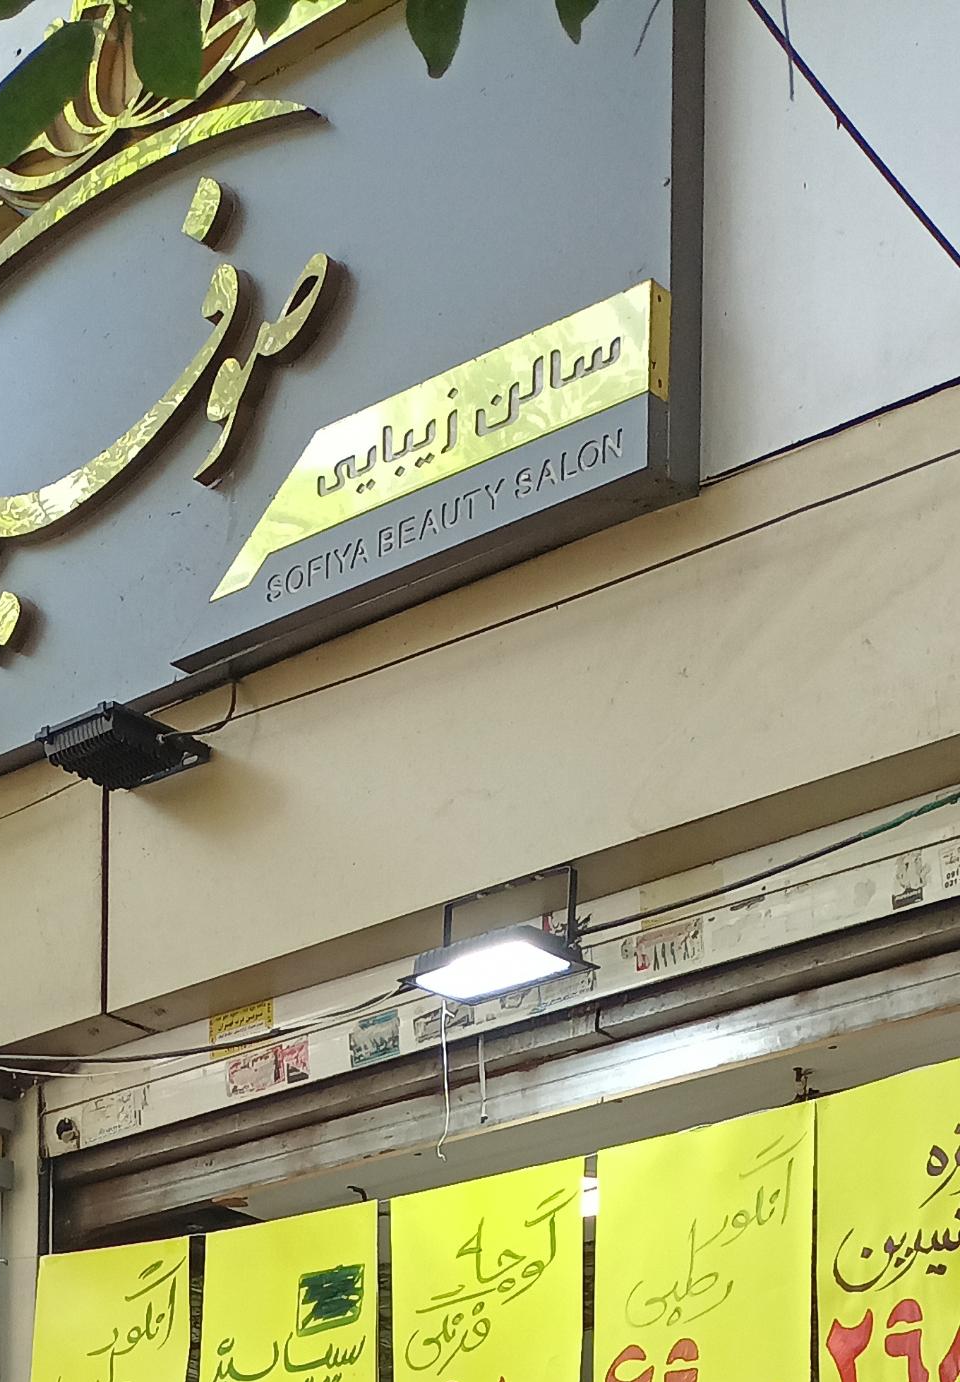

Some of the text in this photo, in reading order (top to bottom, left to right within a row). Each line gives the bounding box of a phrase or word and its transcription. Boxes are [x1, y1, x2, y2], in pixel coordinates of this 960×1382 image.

[316, 336, 622, 498] سالن زیبایی
[266, 427, 624, 603] SOFIYA BEAUTY SALON
[456, 1188, 578, 1306] گوجه
[695, 1131, 807, 1252] انگور
[87, 1255, 187, 1357] انگور
